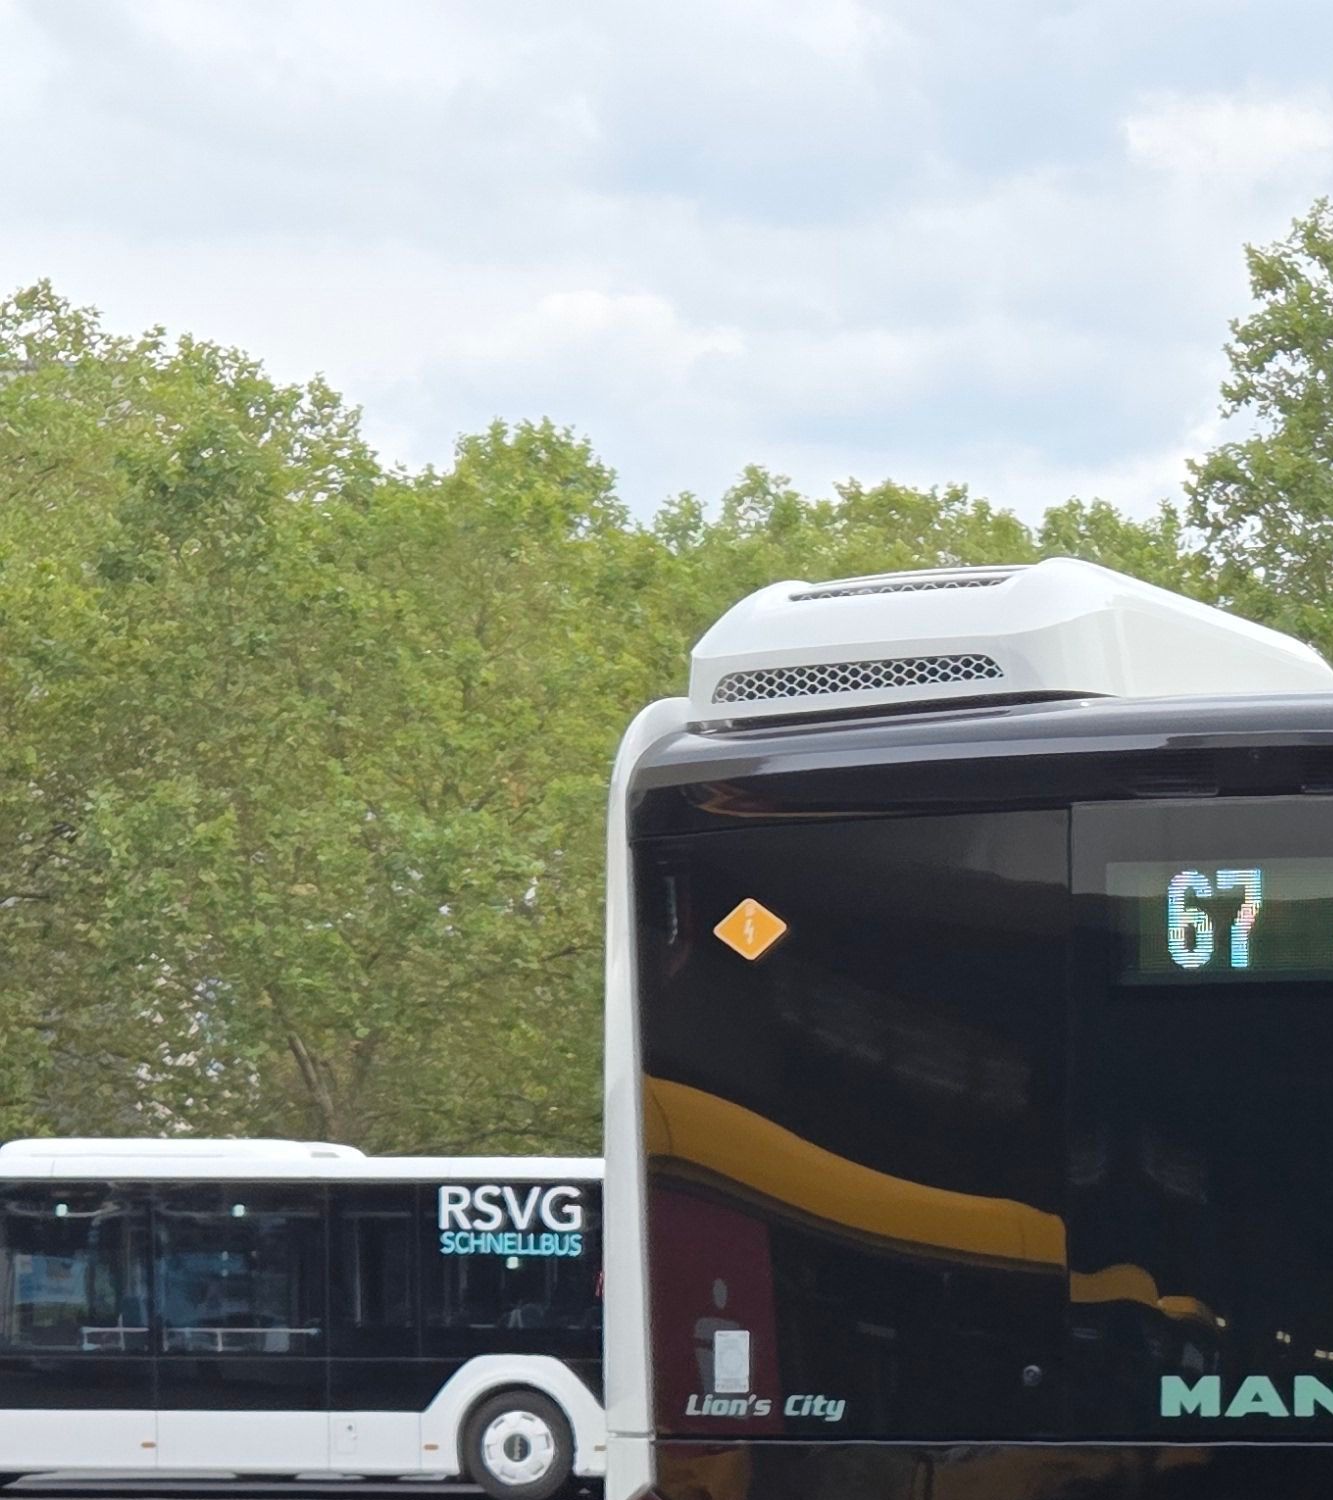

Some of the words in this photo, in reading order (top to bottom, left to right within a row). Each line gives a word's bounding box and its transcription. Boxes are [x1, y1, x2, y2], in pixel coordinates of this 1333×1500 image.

[1167, 869, 1262, 968] 67
[438, 1185, 582, 1231] RSVG
[440, 1231, 582, 1256] SCHNELLBUS
[685, 1394, 772, 1416] Lion's
[784, 1394, 846, 1422] City
